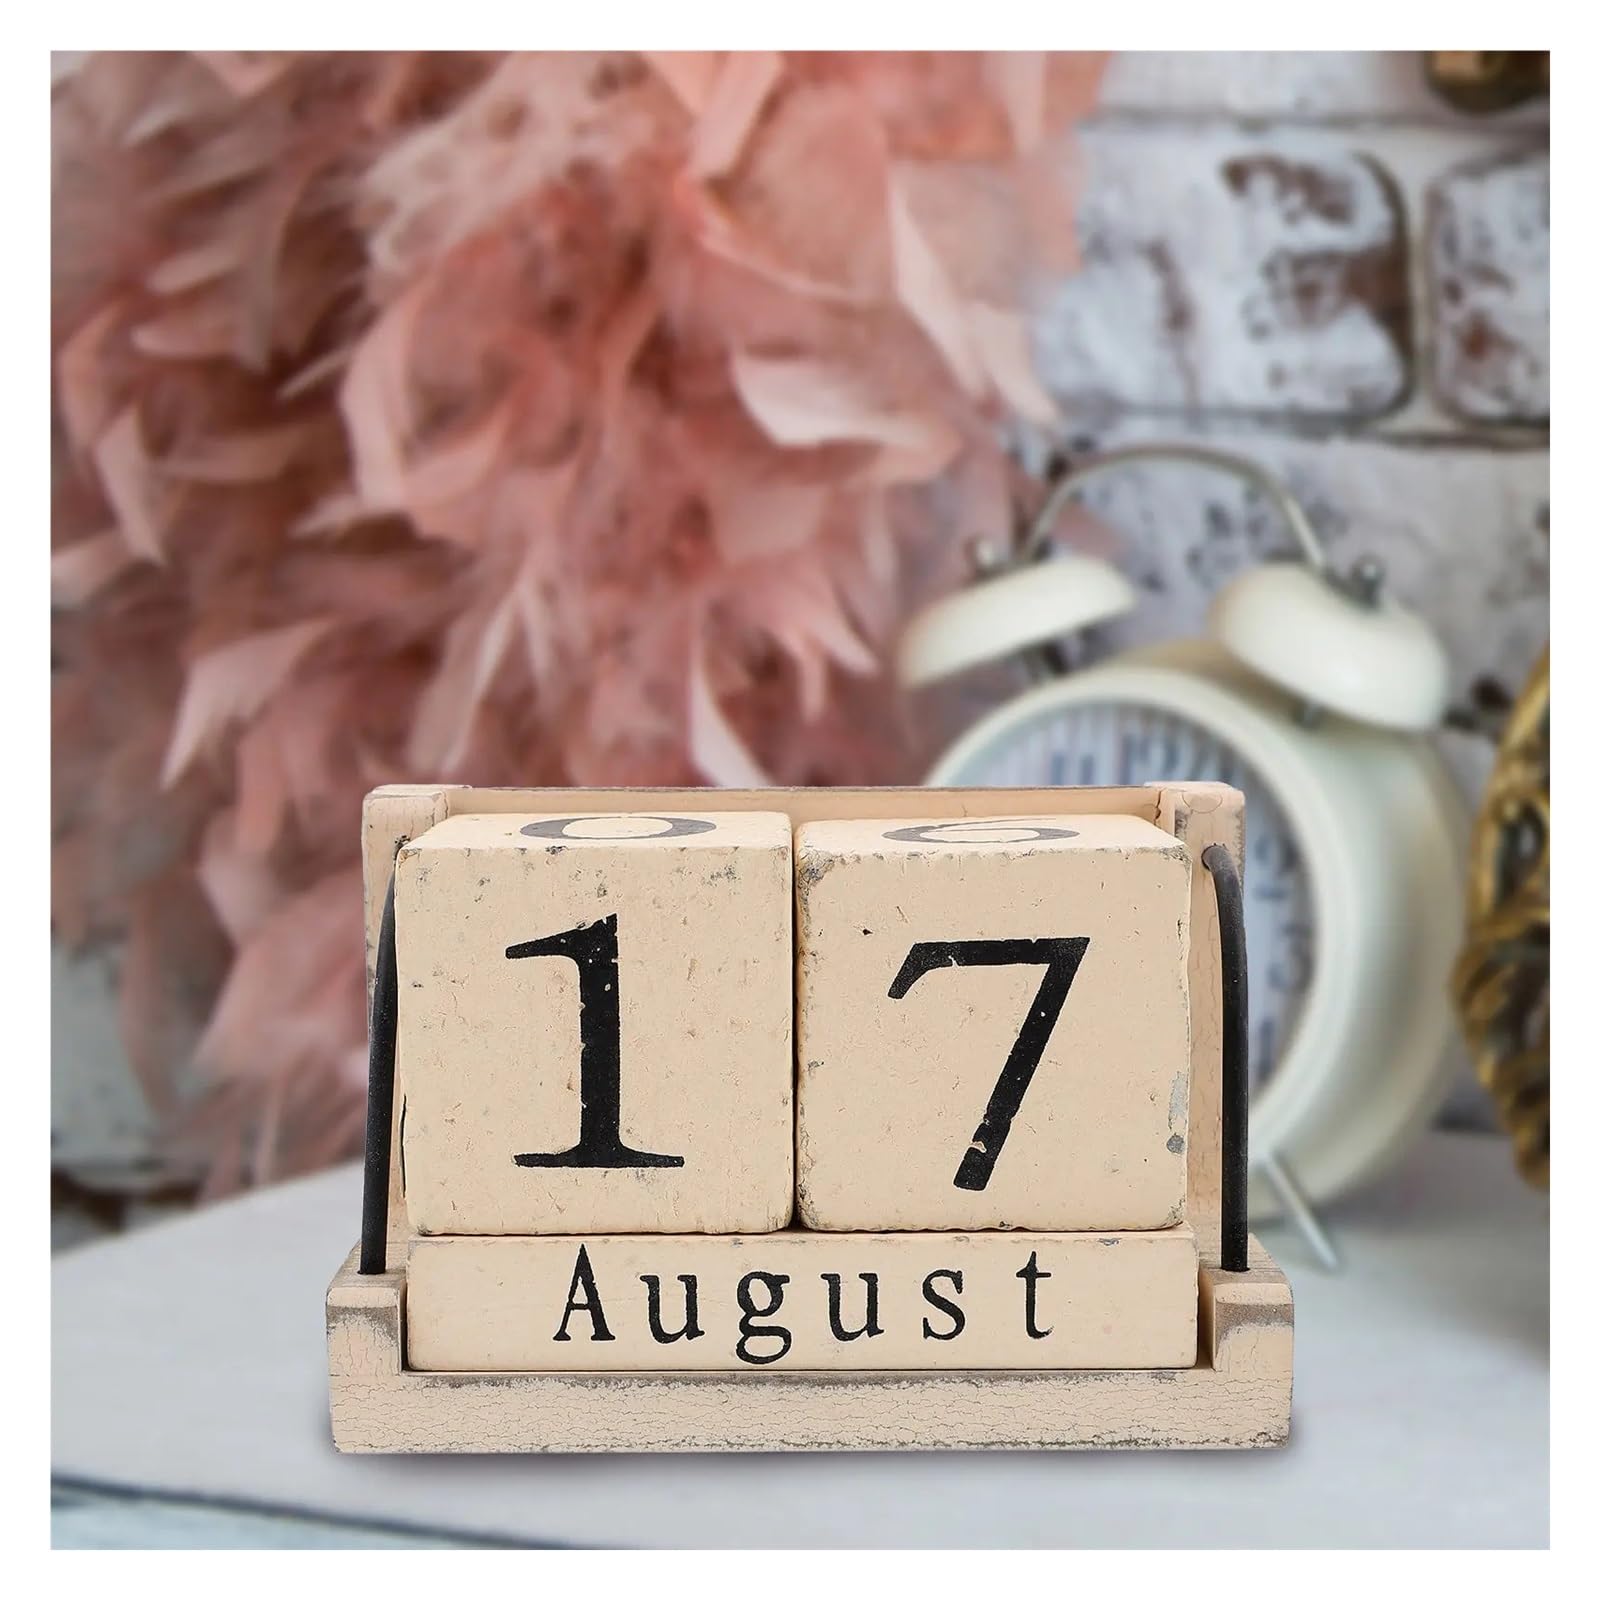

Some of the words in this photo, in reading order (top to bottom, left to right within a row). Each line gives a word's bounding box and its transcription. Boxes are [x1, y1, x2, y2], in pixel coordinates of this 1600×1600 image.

[505, 913, 685, 1169] 1
[887, 936, 1091, 1192] 7
[552, 1243, 1053, 1365] August
